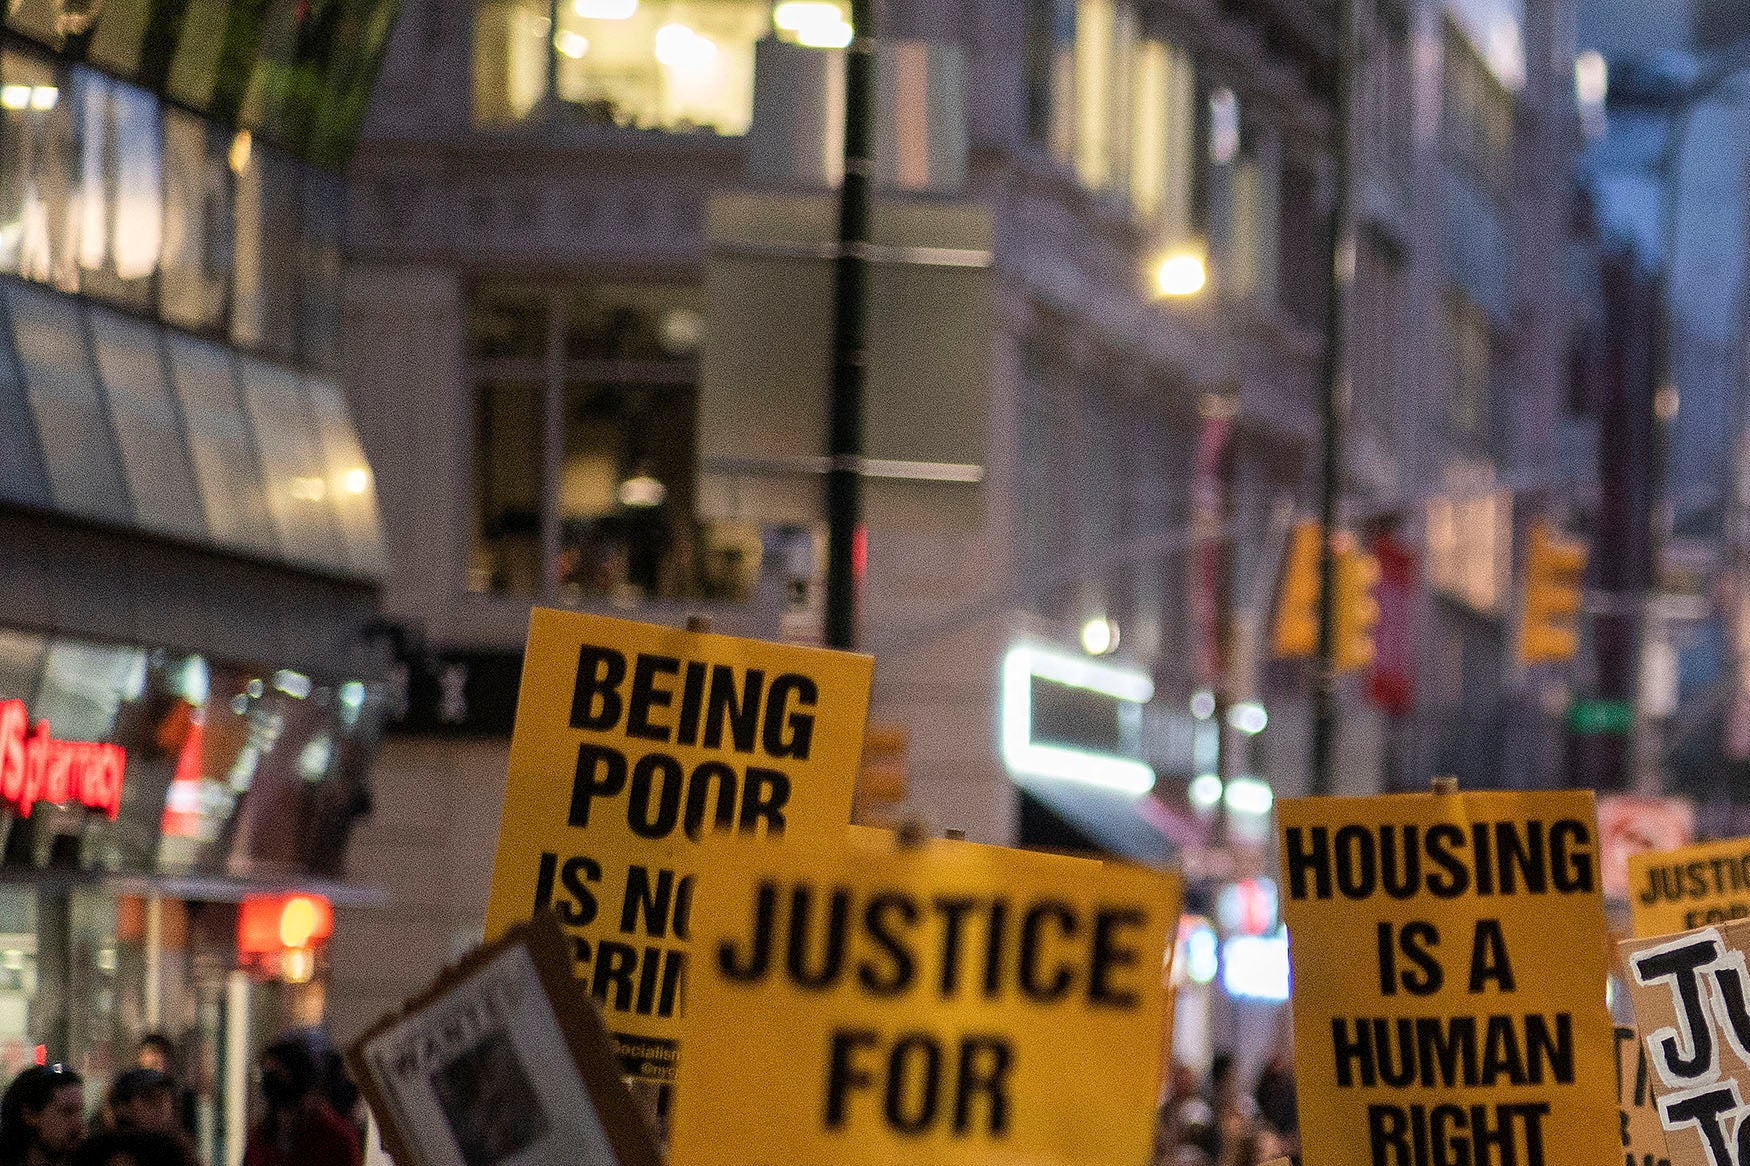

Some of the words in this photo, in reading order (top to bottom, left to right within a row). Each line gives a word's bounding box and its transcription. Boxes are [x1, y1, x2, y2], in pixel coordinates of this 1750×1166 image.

[569, 643, 819, 760] BEING
[568, 743, 792, 843] POOR
[533, 853, 601, 926] IS
[1285, 819, 1595, 899] HOUSING
[716, 879, 1149, 1009] JUSTICE
[1378, 919, 1444, 996] IS
[1467, 918, 1516, 994] A
[822, 1027, 1015, 1136] FOR
[1331, 1012, 1575, 1089] HUMAN
